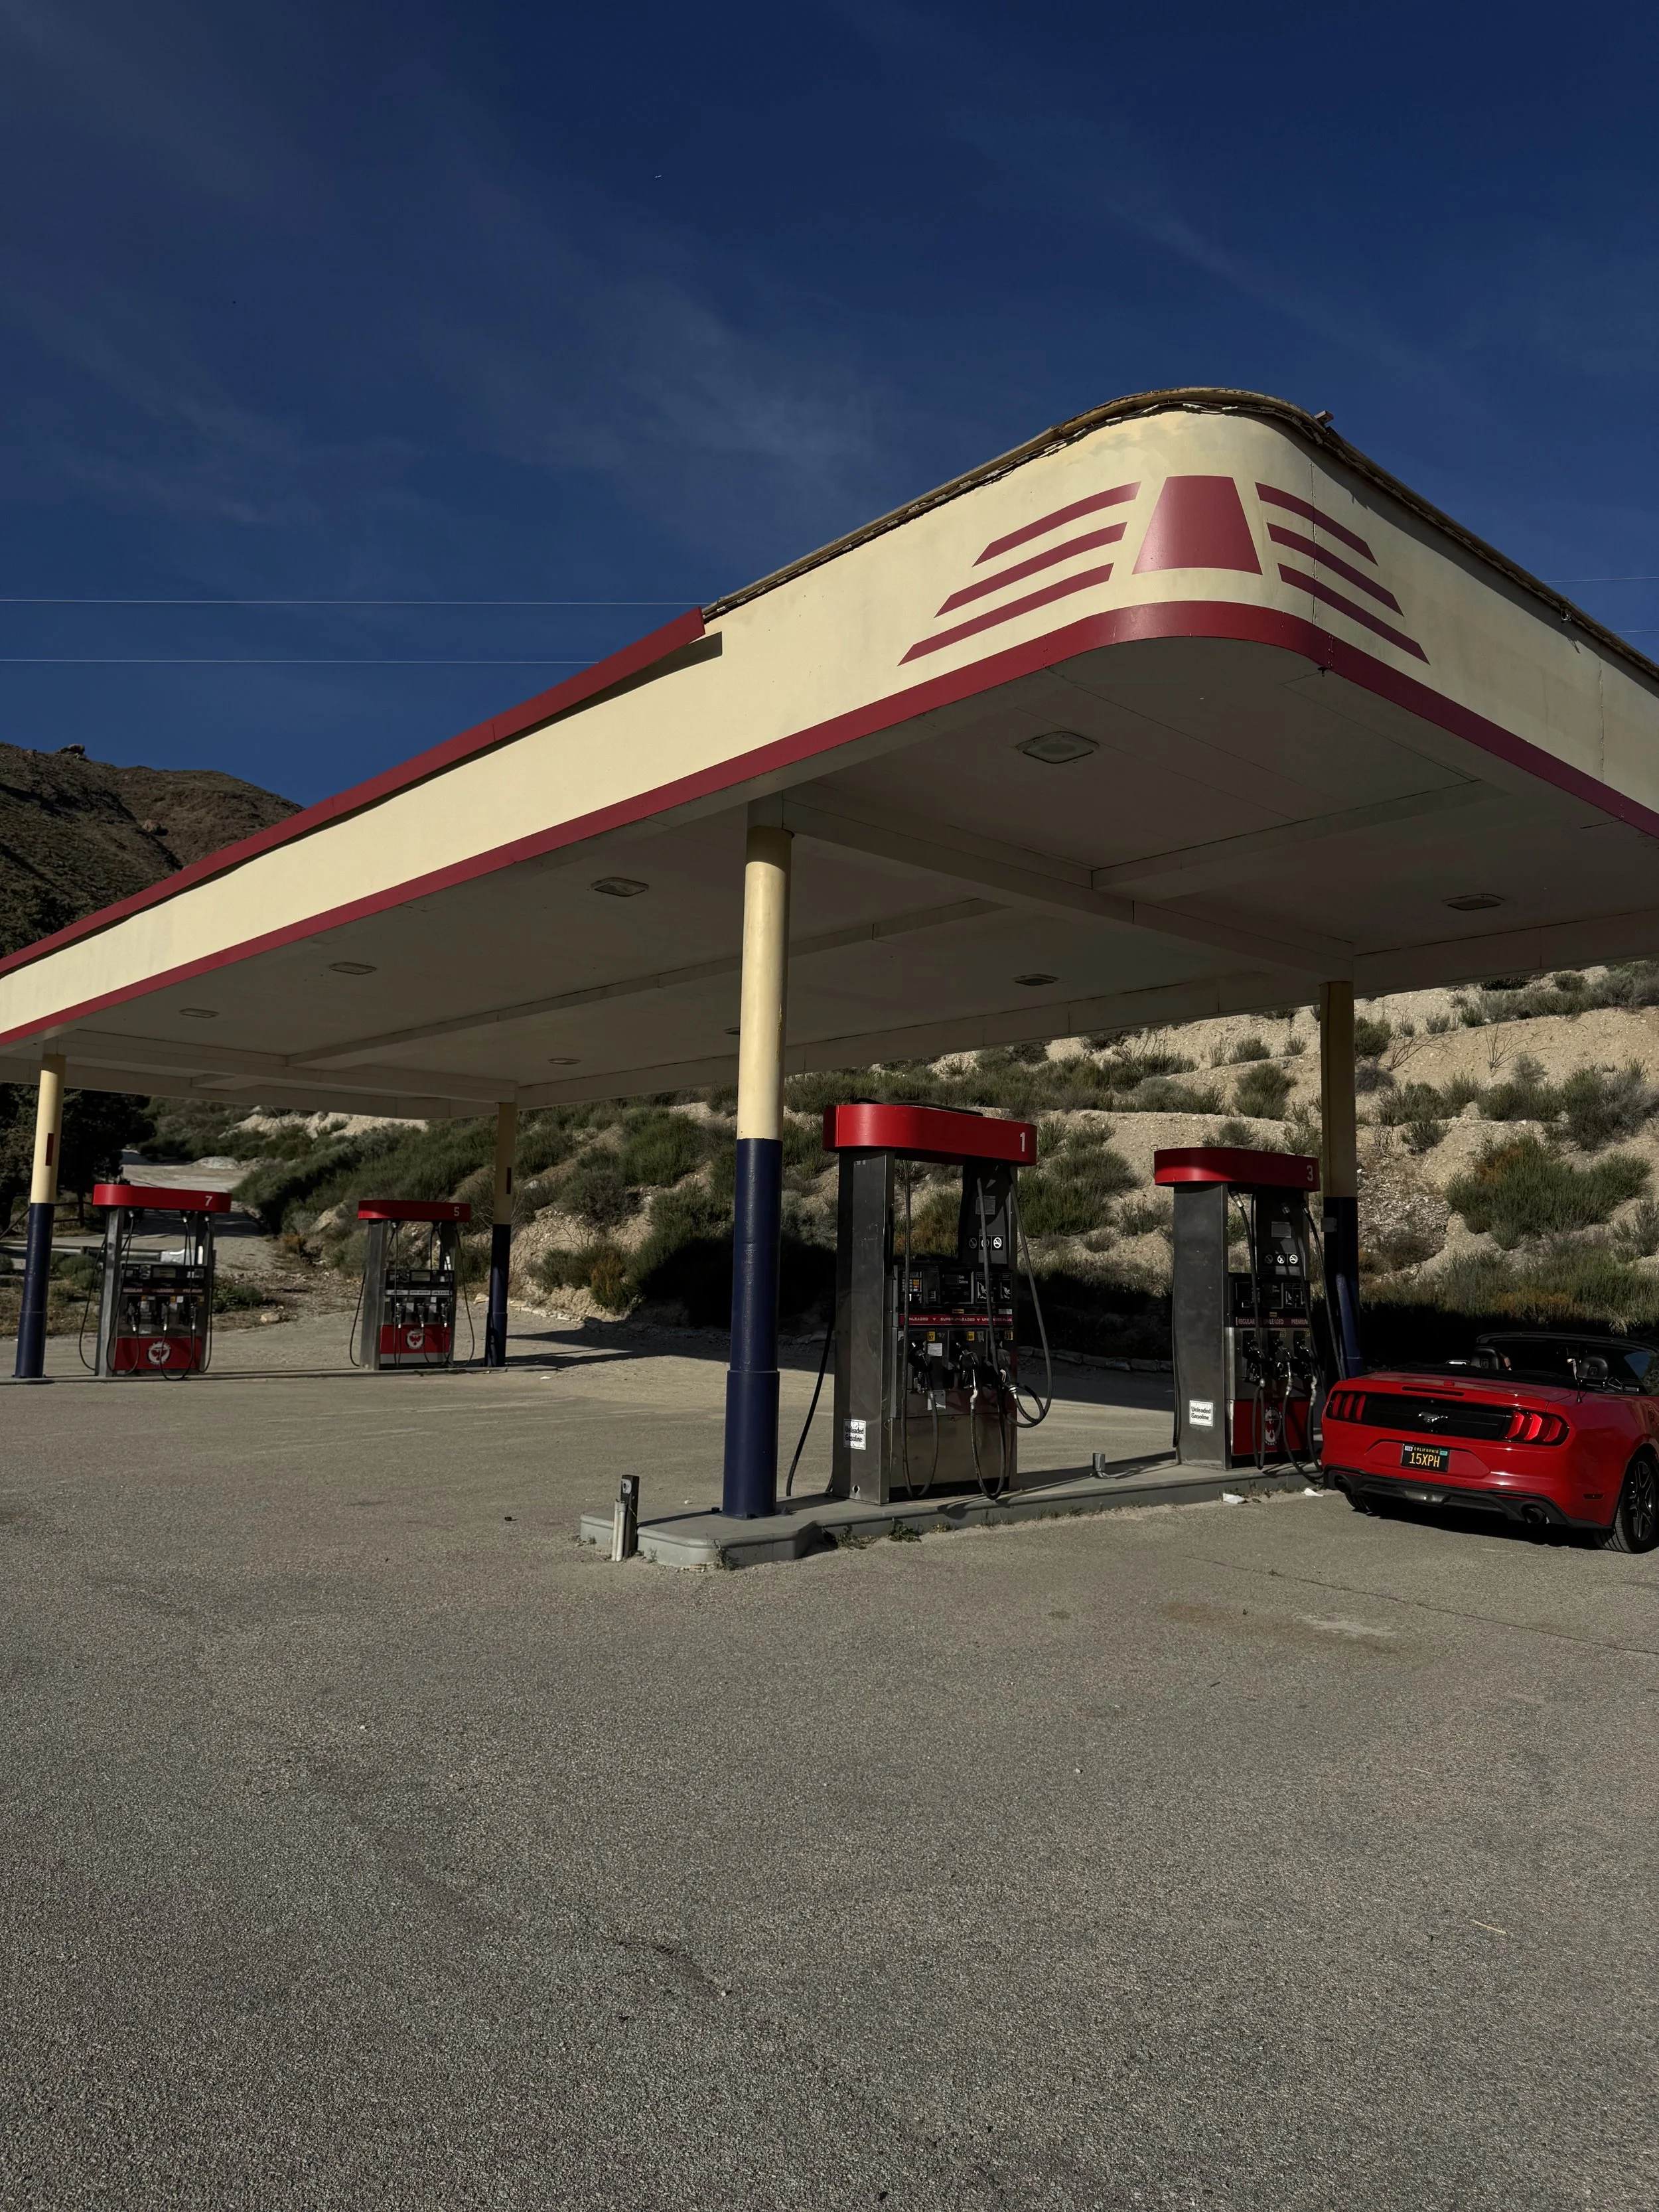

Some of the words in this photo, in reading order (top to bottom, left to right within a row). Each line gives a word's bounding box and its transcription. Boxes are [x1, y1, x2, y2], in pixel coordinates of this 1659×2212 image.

[1019, 1132, 1025, 1152] 1
[1307, 1165, 1314, 1182] 3
[205, 1195, 213, 1207] 7
[453, 1207, 460, 1217] 5
[845, 1426, 864, 1434] Unleaded
[845, 1434, 863, 1443] Gasoline
[1409, 1452, 1440, 1467] 15XPH
